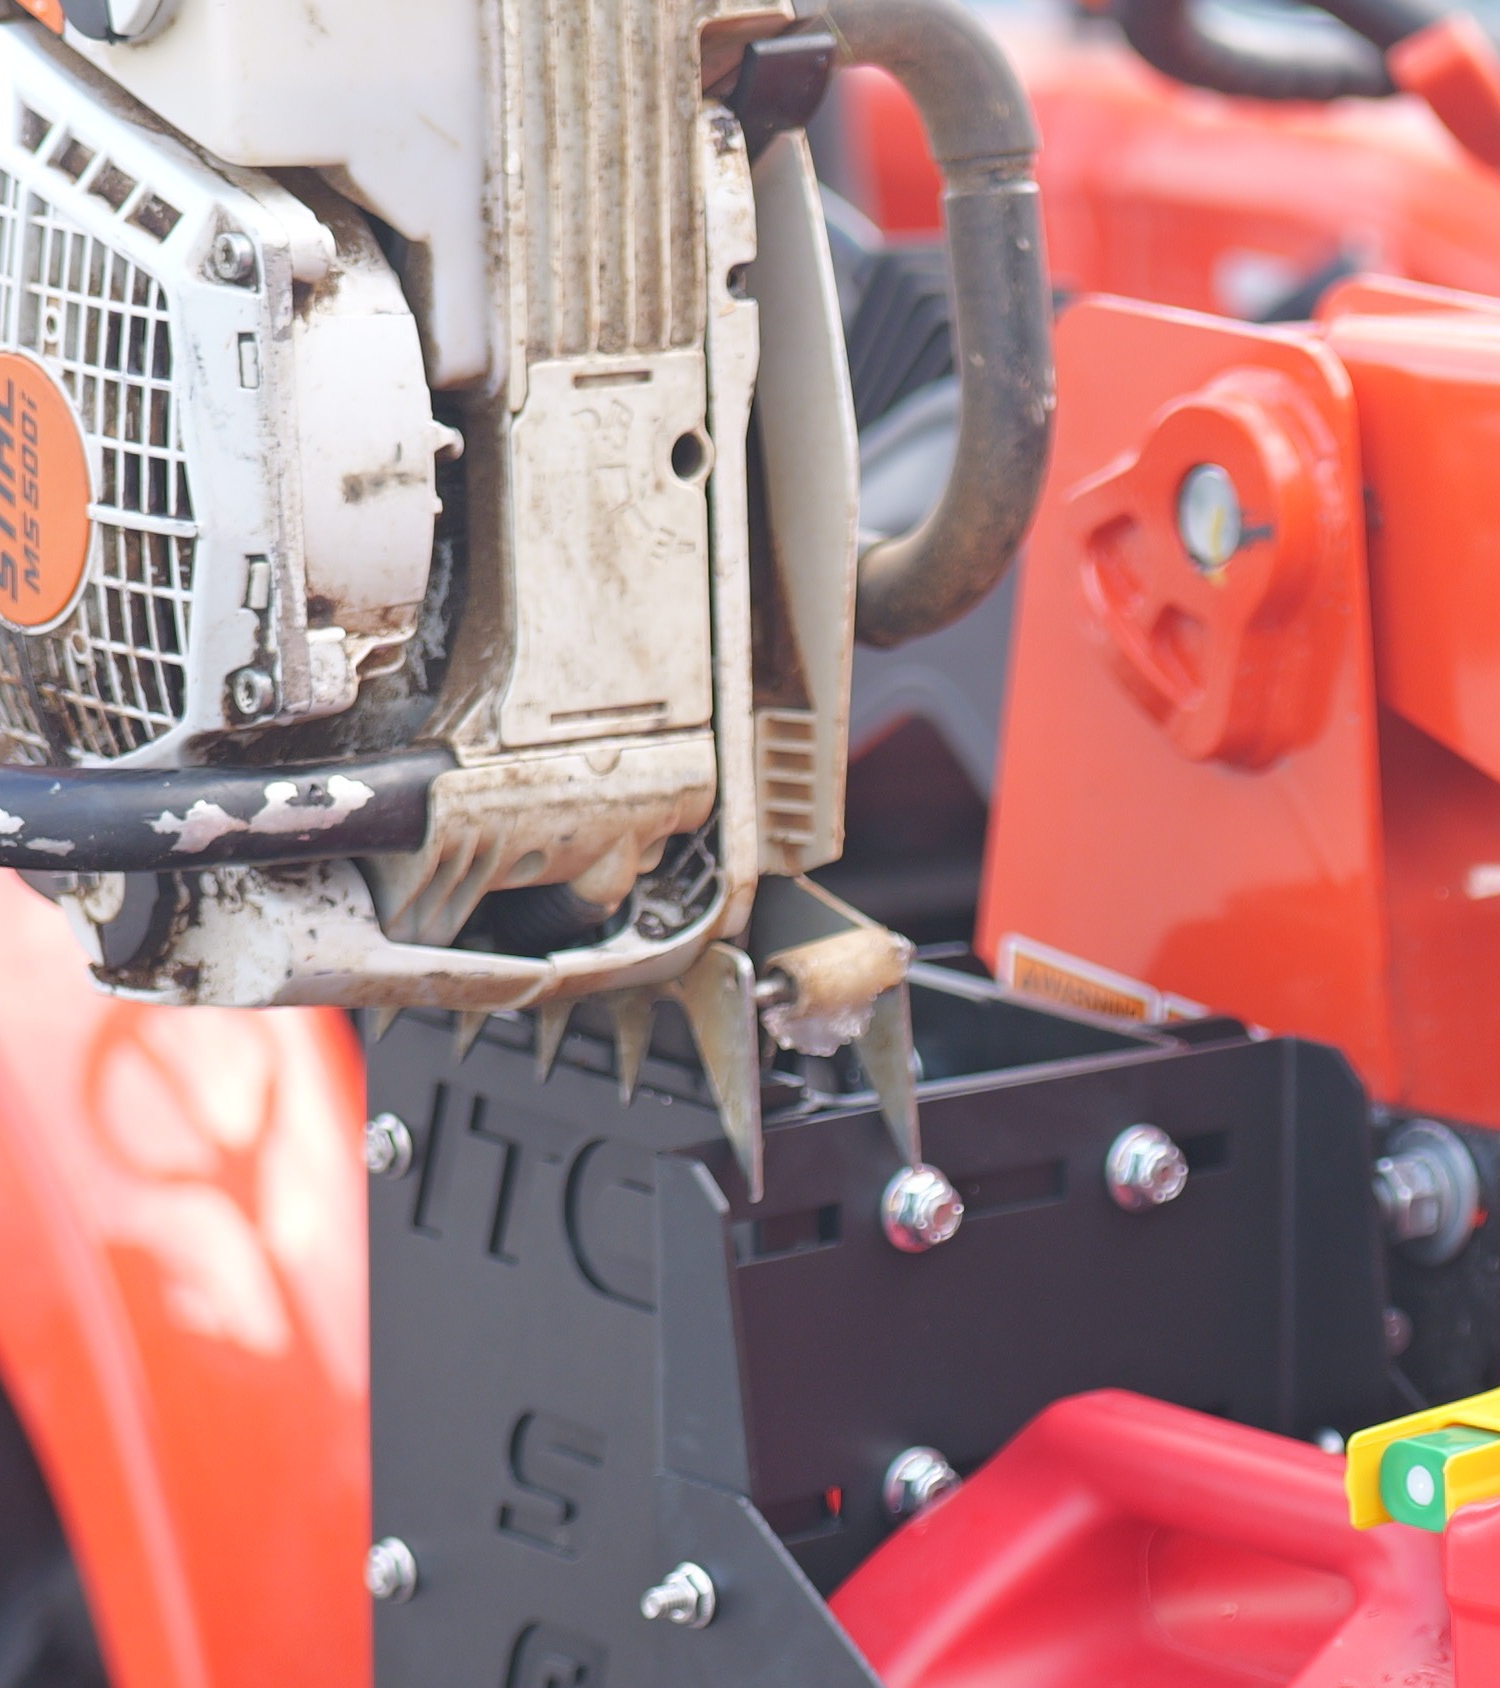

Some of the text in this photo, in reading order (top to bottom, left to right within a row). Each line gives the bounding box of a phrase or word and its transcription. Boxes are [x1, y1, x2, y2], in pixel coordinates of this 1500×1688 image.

[20, 388, 41, 596] MS 500i
[410, 1079, 658, 1316] ITC
